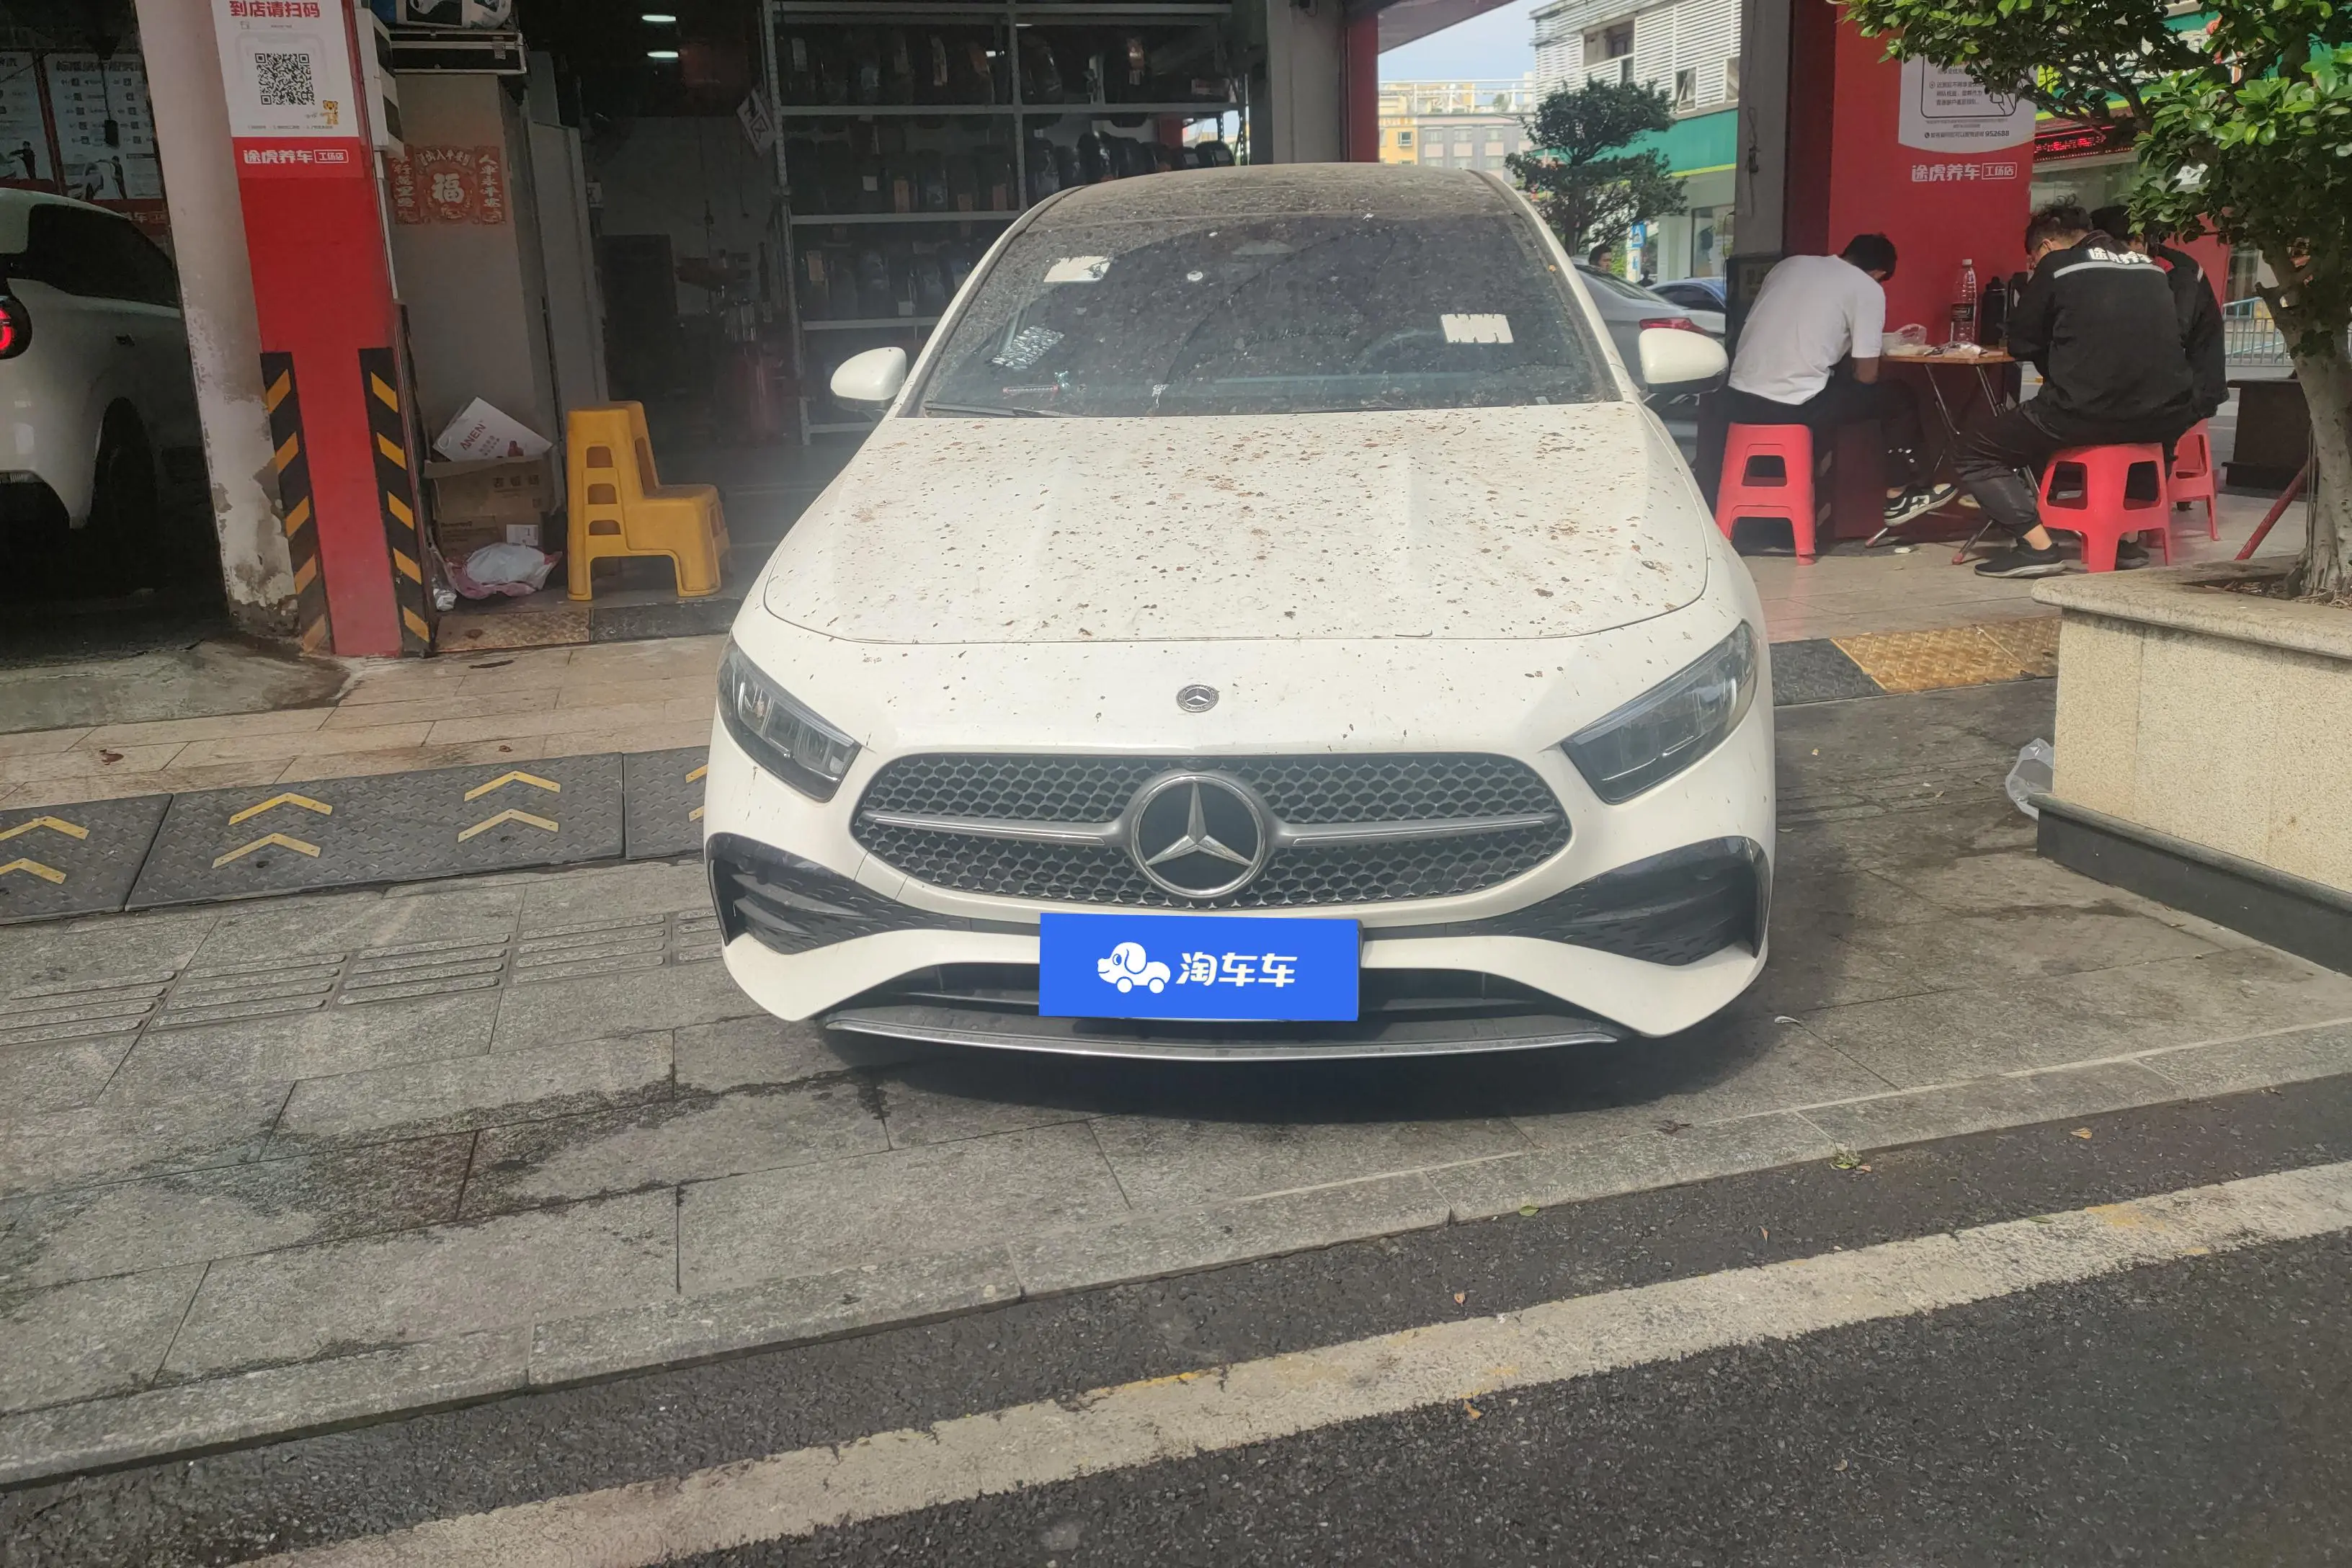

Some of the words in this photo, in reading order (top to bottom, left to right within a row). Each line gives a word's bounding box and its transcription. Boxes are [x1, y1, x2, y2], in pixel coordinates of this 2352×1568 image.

[229, 1, 320, 17] 到店请扫码
[243, 149, 313, 164] 途虎养车
[318, 152, 344, 161] 工场店
[1912, 164, 1980, 182] 途虎养车
[1984, 166, 2014, 177] 工场店
[432, 173, 465, 203] 福
